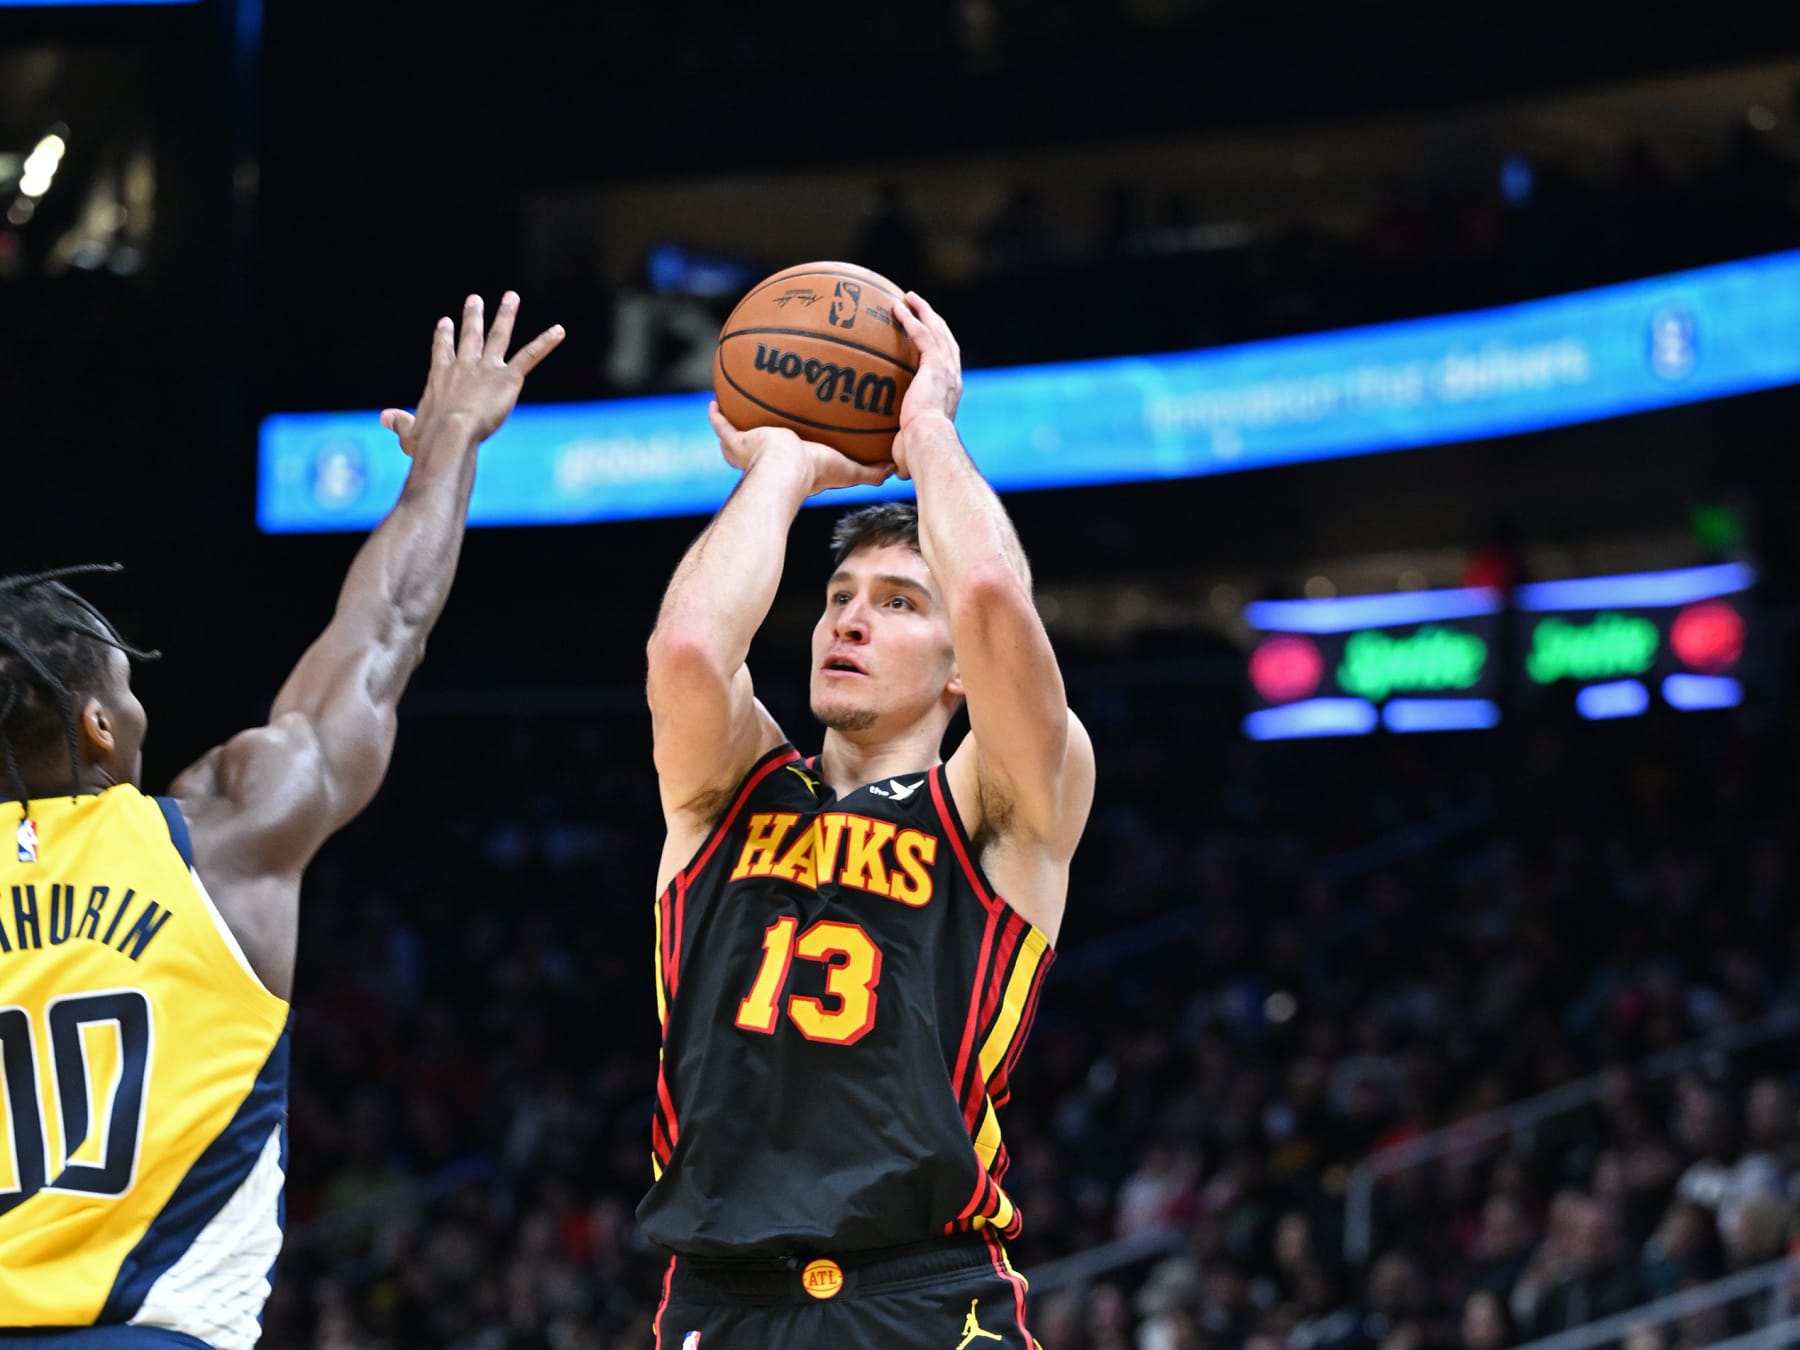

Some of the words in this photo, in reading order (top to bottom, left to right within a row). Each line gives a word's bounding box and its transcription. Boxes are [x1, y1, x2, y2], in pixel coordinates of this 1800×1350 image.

[754, 342, 897, 416] Wilson
[729, 811, 938, 908] HAWKS
[734, 915, 883, 1046] 13
[809, 1270, 838, 1287] ATL
